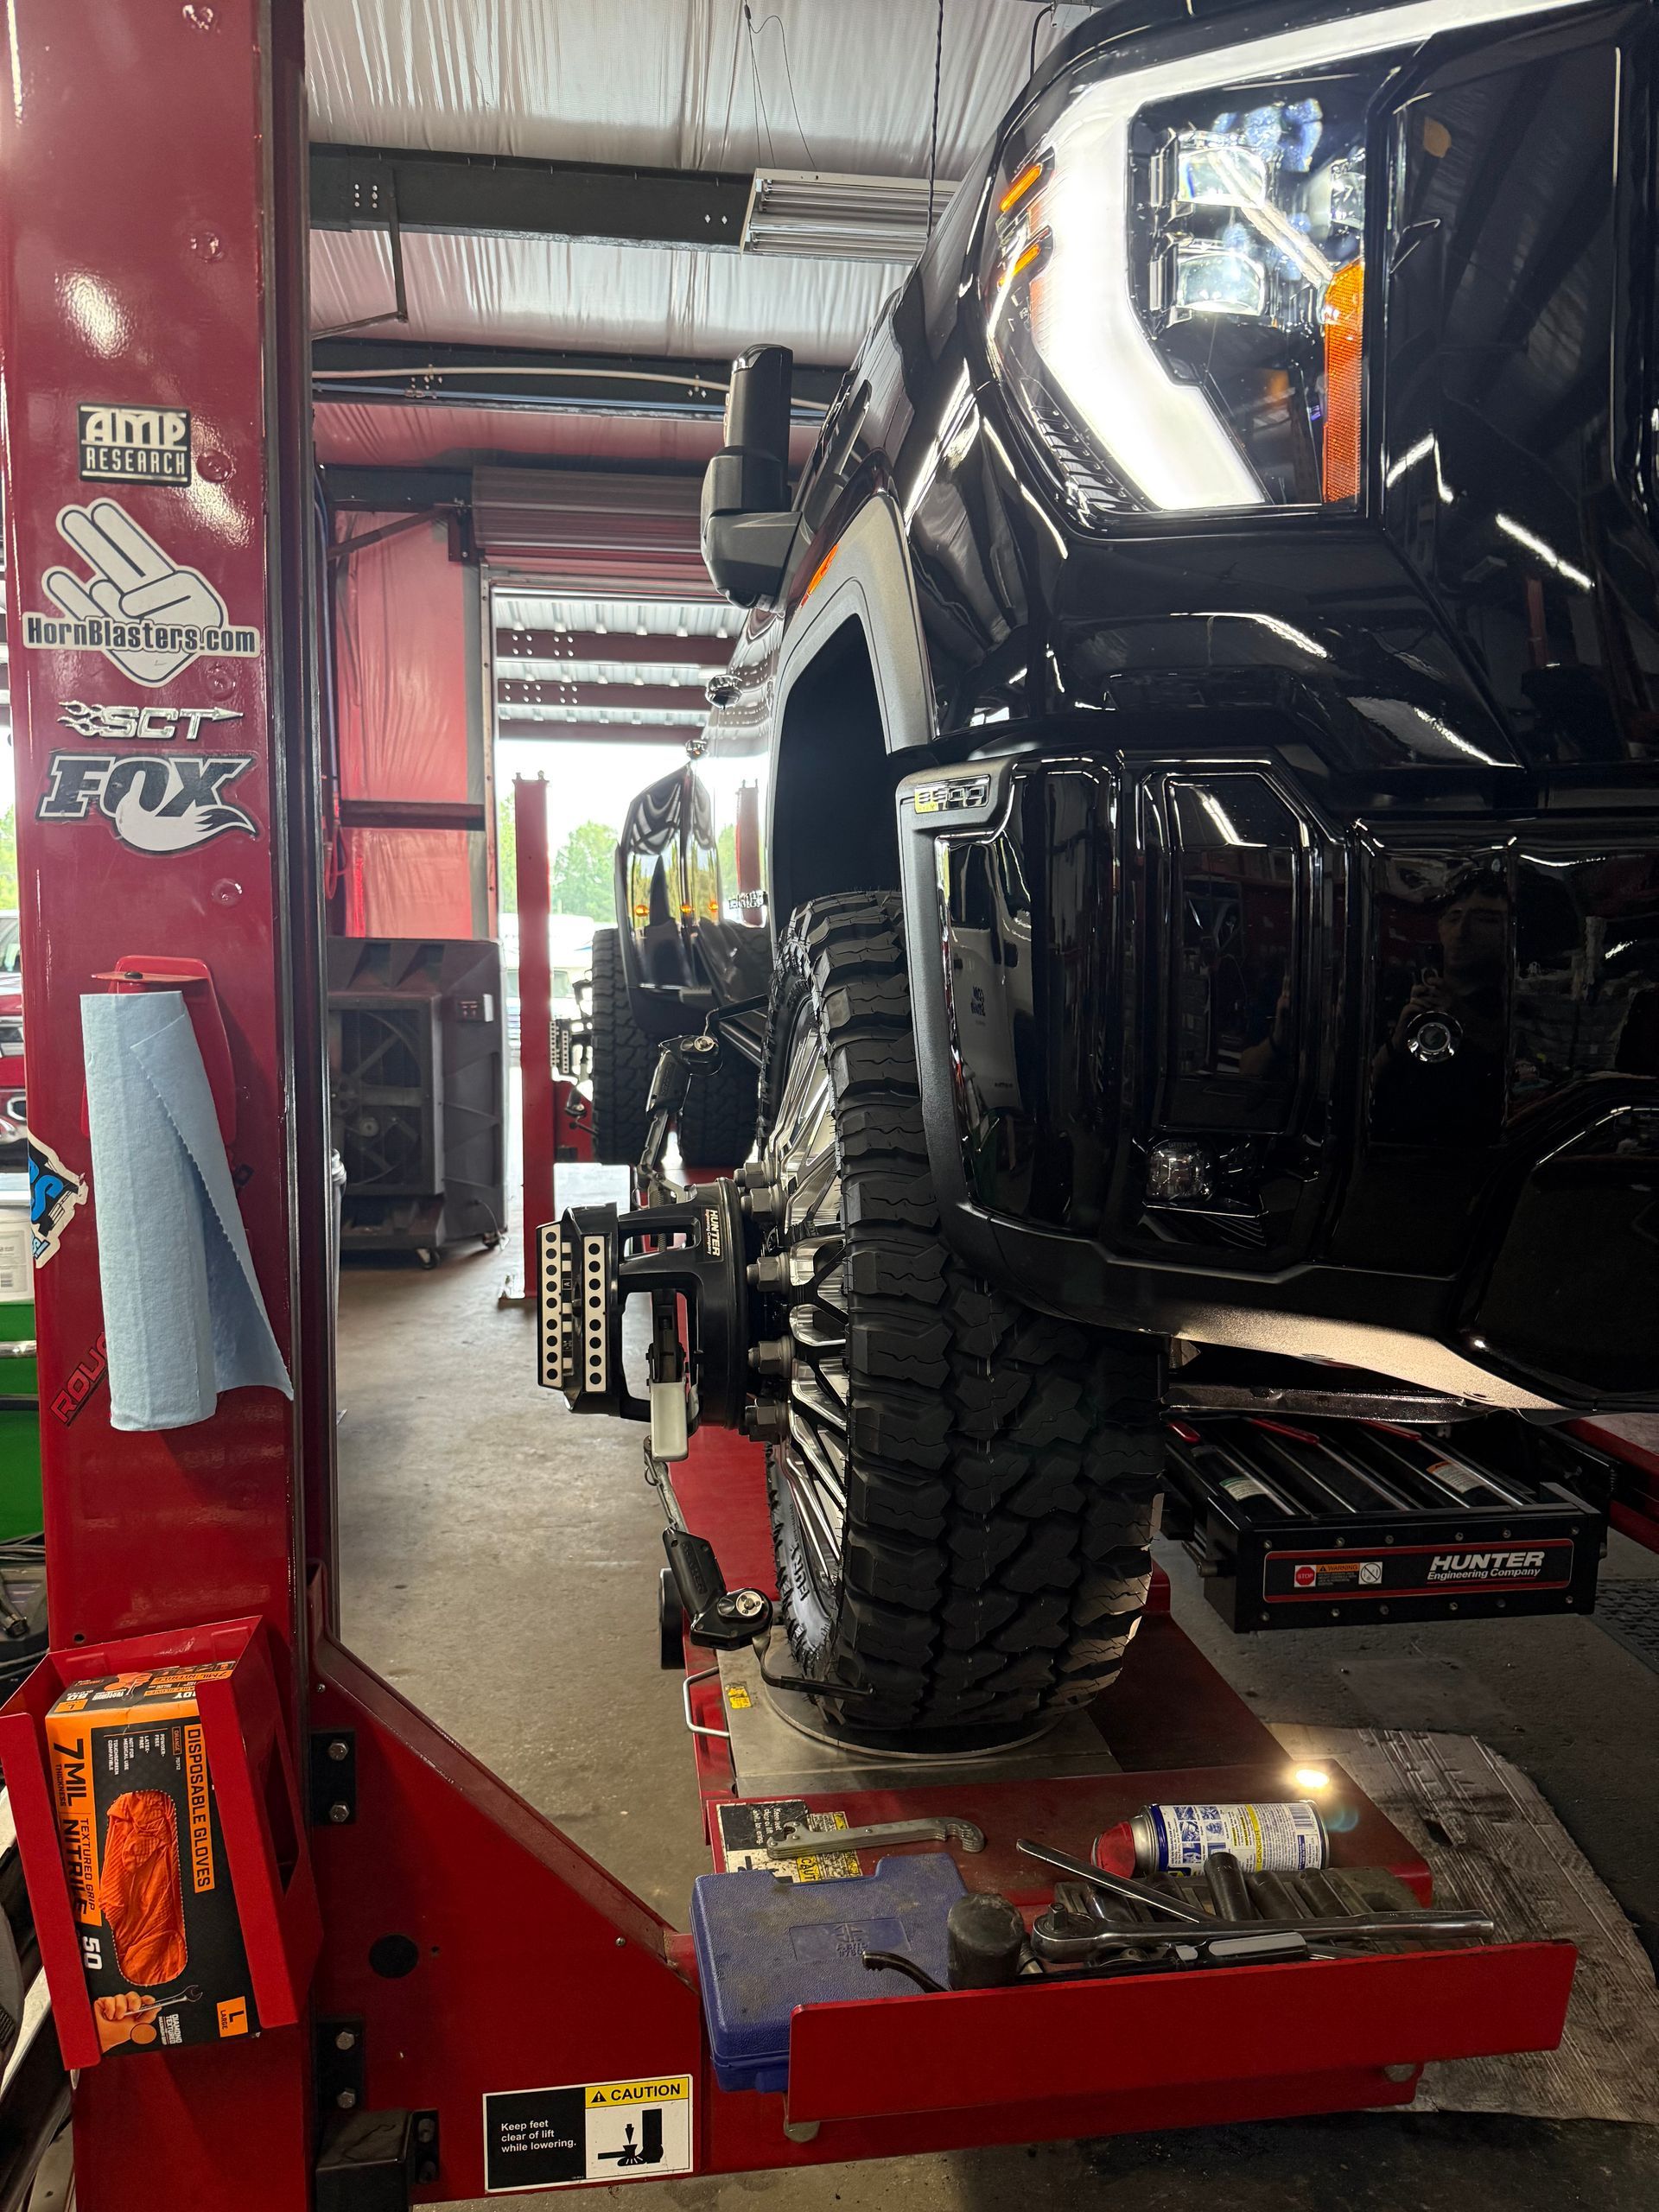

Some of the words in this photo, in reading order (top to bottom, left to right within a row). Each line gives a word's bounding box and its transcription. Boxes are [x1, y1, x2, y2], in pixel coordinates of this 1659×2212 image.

[86, 410, 186, 447] AMP
[86, 447, 186, 475] RESEARCH
[28, 617, 256, 653] HornBlasters.com
[99, 705, 244, 741] SCT
[39, 754, 257, 830] FOX
[709, 1210, 720, 1256] HUNTER
[50, 1332, 107, 1423] ROU
[1427, 1569, 1488, 1580] Engineering
[1491, 1567, 1541, 1577] Company
[1429, 1551, 1545, 1571] HUNTER
[56, 1764, 67, 1808] THICKNESS
[188, 1729, 206, 1824] DISPOSABLE
[63, 1820, 87, 1915] NITRILE
[80, 1818, 92, 1882] TEXTURED
[86, 1884, 95, 1910] GRIP
[194, 1827, 210, 1888] GLOVES
[801, 1859, 816, 1879] CAUT
[81, 1935, 103, 1971] 50
[166, 2014, 176, 2044] TEXTURED
[171, 2013, 182, 2044] DIAMOND
[229, 2010, 245, 2023] L
[610, 2083, 681, 2101] CAUTION
[501, 2122, 527, 2132] Keep
[530, 2120, 549, 2128] feet
[501, 2133, 526, 2142] clear
[529, 2130, 539, 2139] of
[542, 2129, 555, 2139] lift
[501, 2143, 528, 2152] while
[531, 2139, 576, 2150] lowering.
